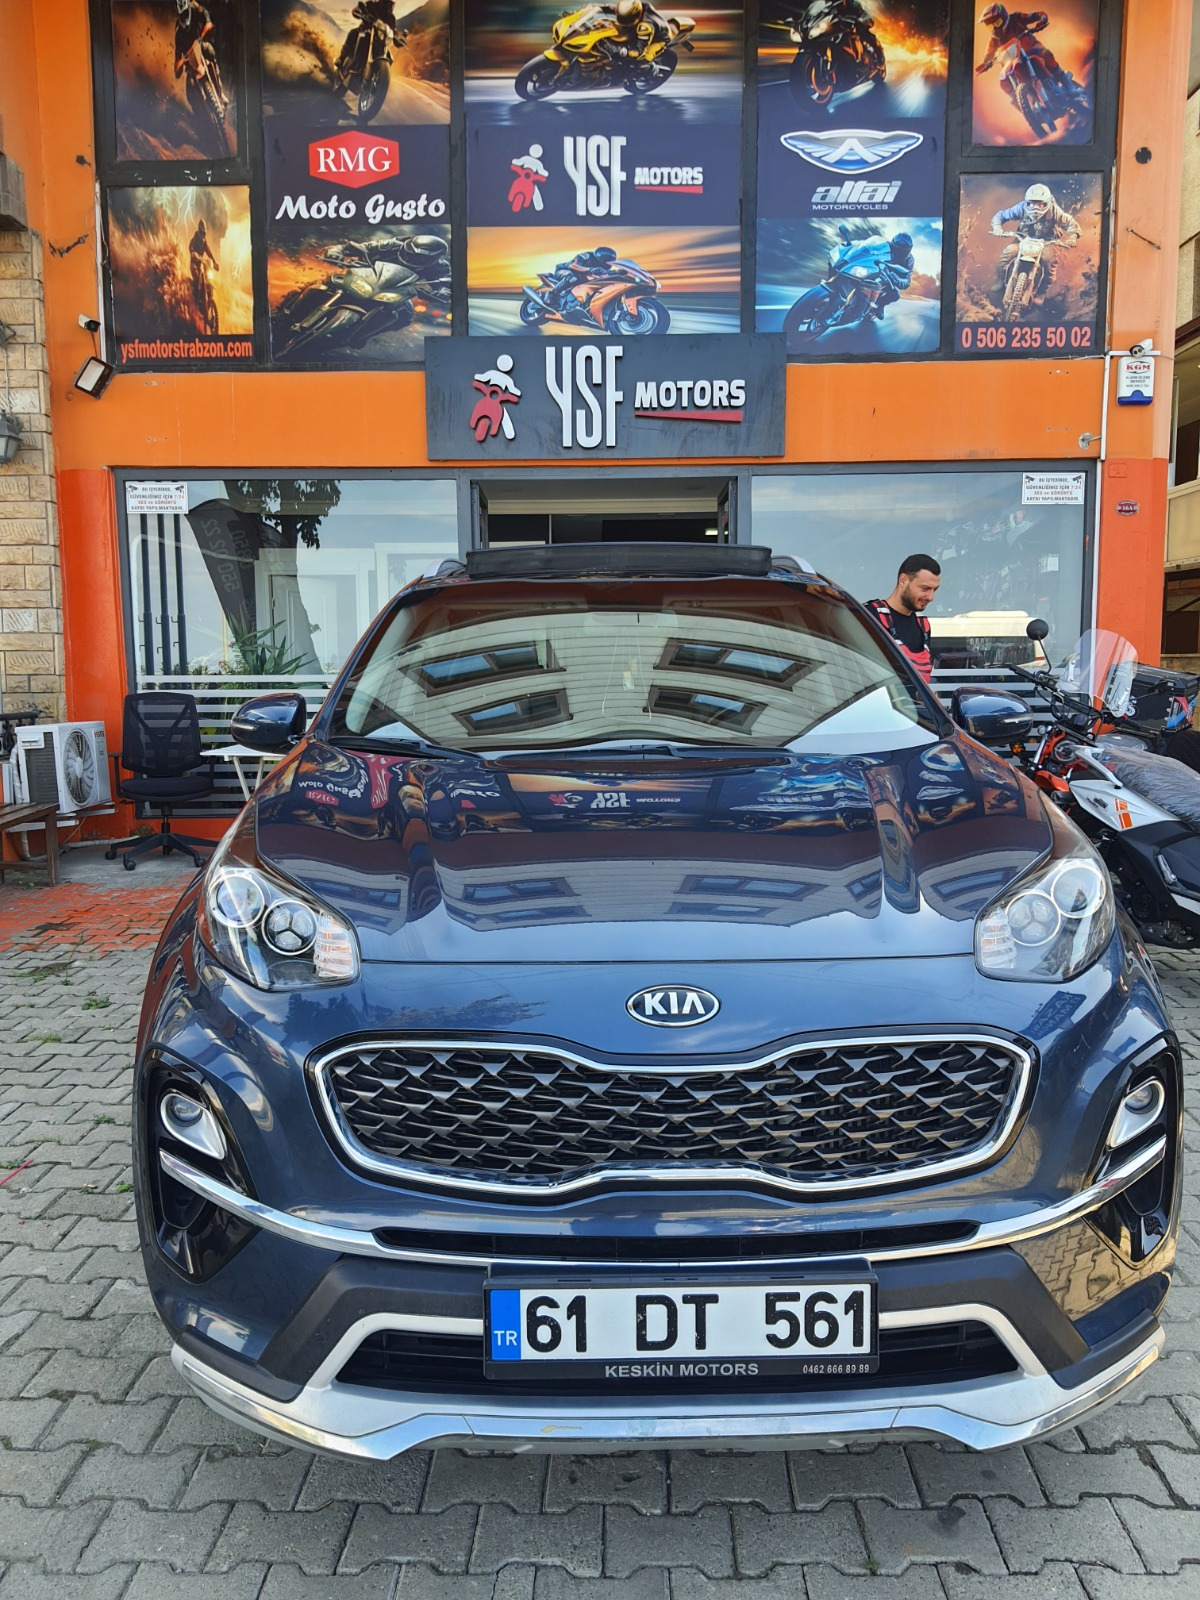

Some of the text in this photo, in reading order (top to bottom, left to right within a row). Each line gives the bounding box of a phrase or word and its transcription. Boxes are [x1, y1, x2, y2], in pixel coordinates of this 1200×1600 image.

[316, 146, 392, 173] RMG
[563, 134, 704, 216] YSF MOTORS
[275, 193, 446, 225] Moto Gusto
[961, 326, 1092, 348] 0 506 235 50 02
[120, 338, 253, 364] ysfmotorstrabzon.com
[545, 344, 747, 448] YSF MOTORS
[643, 991, 706, 1016] KIA
[526, 1290, 865, 1353] 61 DT 561
[493, 1330, 518, 1346] TR
[605, 1362, 759, 1378] KESKİN MOTORS
[803, 1364, 870, 1375] 0462 666 89 89
